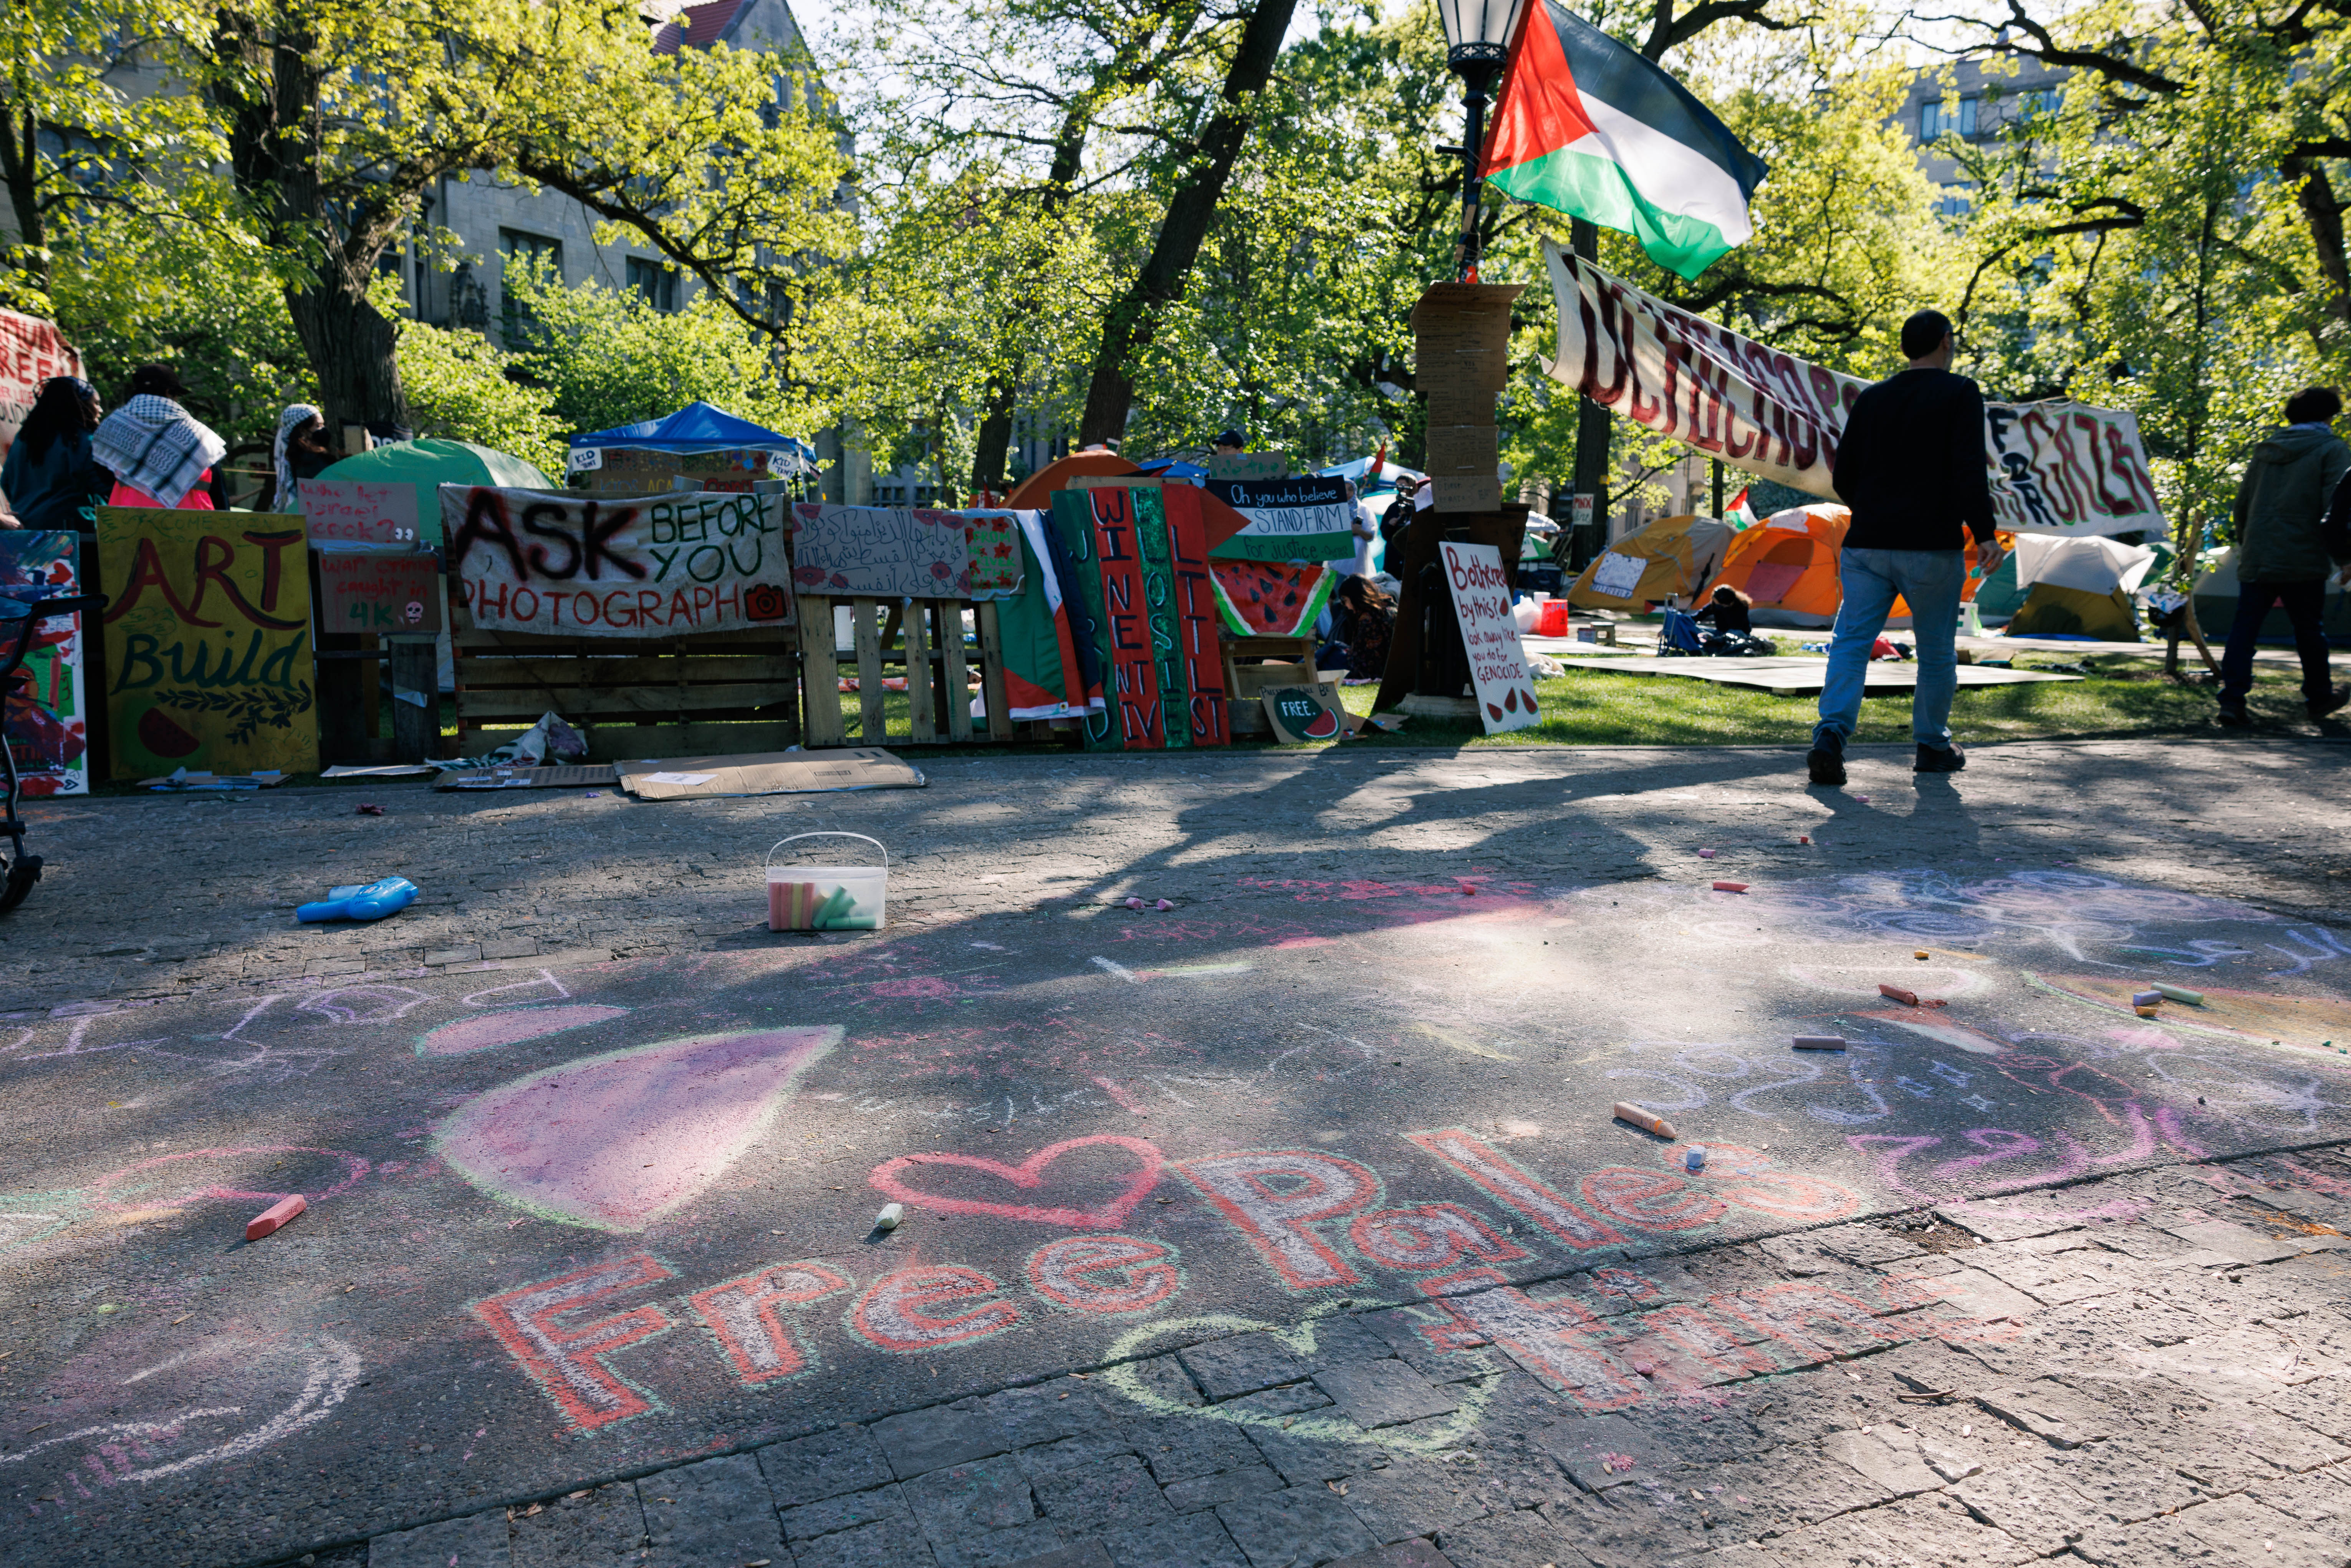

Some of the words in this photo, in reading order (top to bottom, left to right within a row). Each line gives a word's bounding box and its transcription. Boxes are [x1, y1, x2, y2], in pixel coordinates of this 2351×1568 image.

[575, 450, 595, 464] KID
[772, 455, 790, 467] KID
[1231, 484, 1250, 504] Oh
[1256, 493, 1275, 508] you
[1277, 487, 1297, 503] who
[1299, 486, 1337, 502] believe
[1254, 508, 1302, 533] STAND
[1303, 505, 1344, 531] FIRM
[455, 487, 646, 582] ASK
[651, 494, 778, 544] BEFORE
[649, 539, 762, 583] YOU
[1271, 538, 1318, 560] justice
[102, 528, 307, 630] ART
[1446, 546, 1508, 591] Bothered
[409, 580, 427, 599] in
[1107, 570, 1206, 614] NOT
[1458, 594, 1475, 627] by
[1472, 595, 1500, 621] this?
[1484, 631, 1503, 649] away
[1502, 626, 1517, 642] like
[109, 628, 306, 696] Build
[1472, 652, 1485, 666] you
[1487, 648, 1496, 661] do
[1496, 647, 1508, 662] for
[1477, 663, 1524, 685] GENOCIDE
[1281, 700, 1317, 717] FREE.
[1171, 1127, 1864, 1290] Pales
[472, 1235, 1184, 1436] Free
